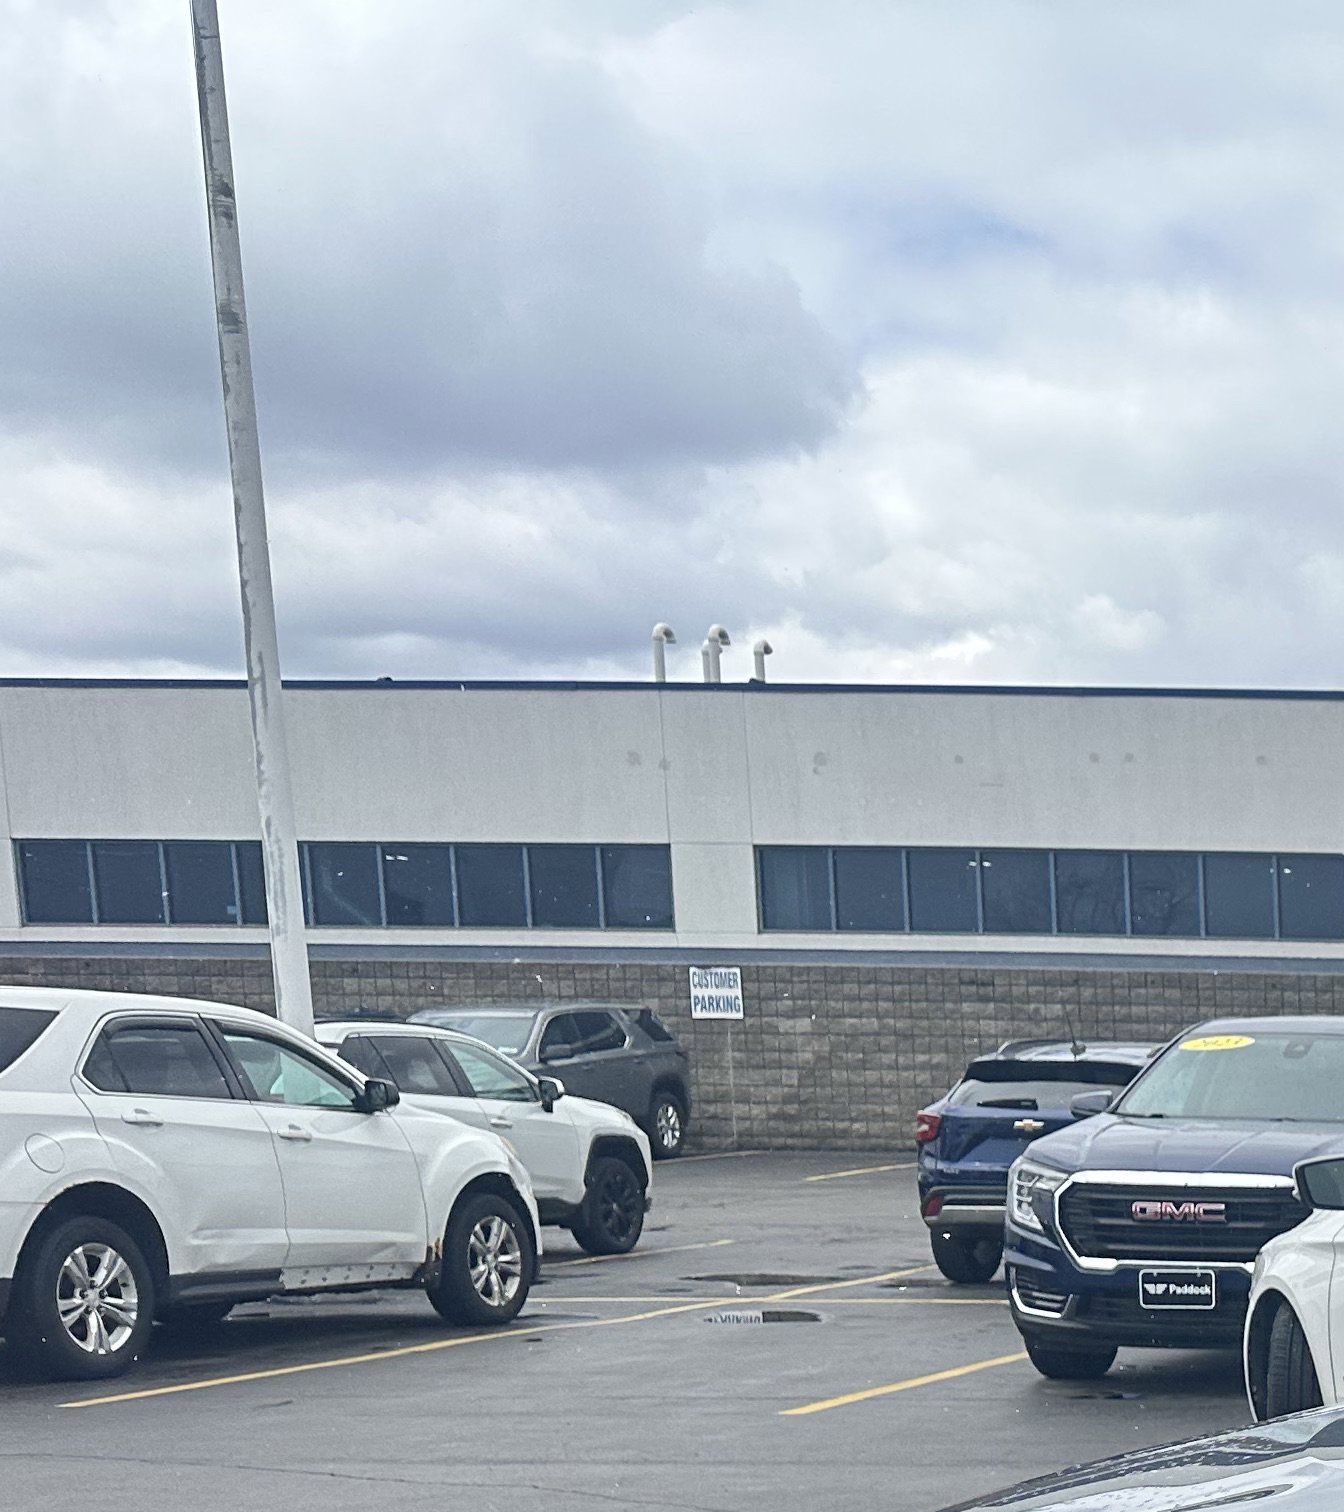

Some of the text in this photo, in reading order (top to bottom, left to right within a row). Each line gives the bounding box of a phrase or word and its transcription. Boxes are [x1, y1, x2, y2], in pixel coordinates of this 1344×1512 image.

[692, 971, 739, 989] CUSTOMER
[693, 995, 741, 1013] PARKING
[1131, 1201, 1226, 1222] GMC
